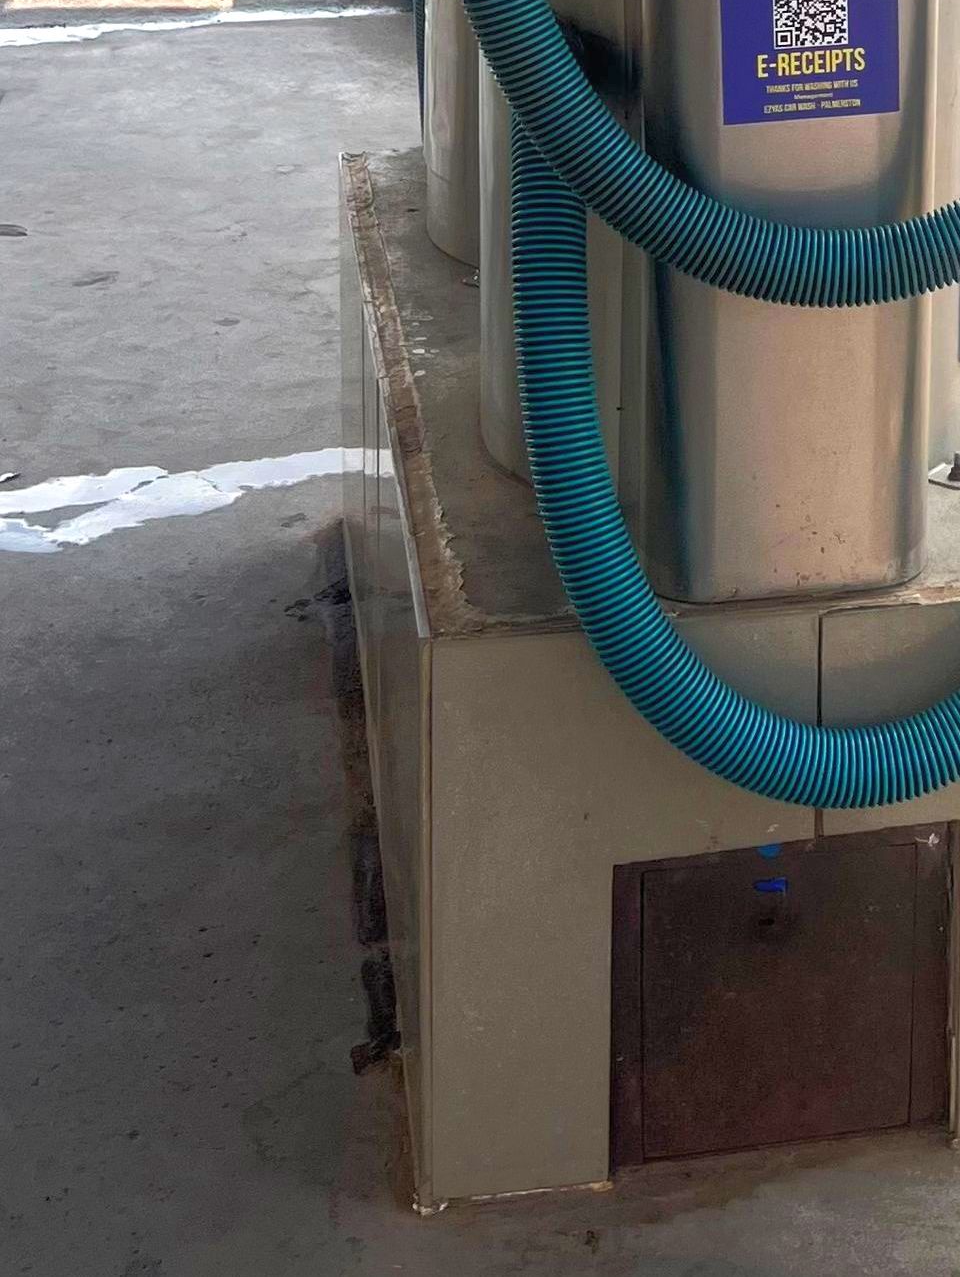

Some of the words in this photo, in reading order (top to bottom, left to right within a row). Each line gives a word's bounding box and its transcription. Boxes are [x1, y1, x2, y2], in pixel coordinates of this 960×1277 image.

[757, 47, 866, 78] E-RECEIPTS
[766, 84, 790, 94] THANKS
[791, 84, 804, 92] FOR
[833, 80, 850, 89] WITH
[849, 79, 859, 87] US
